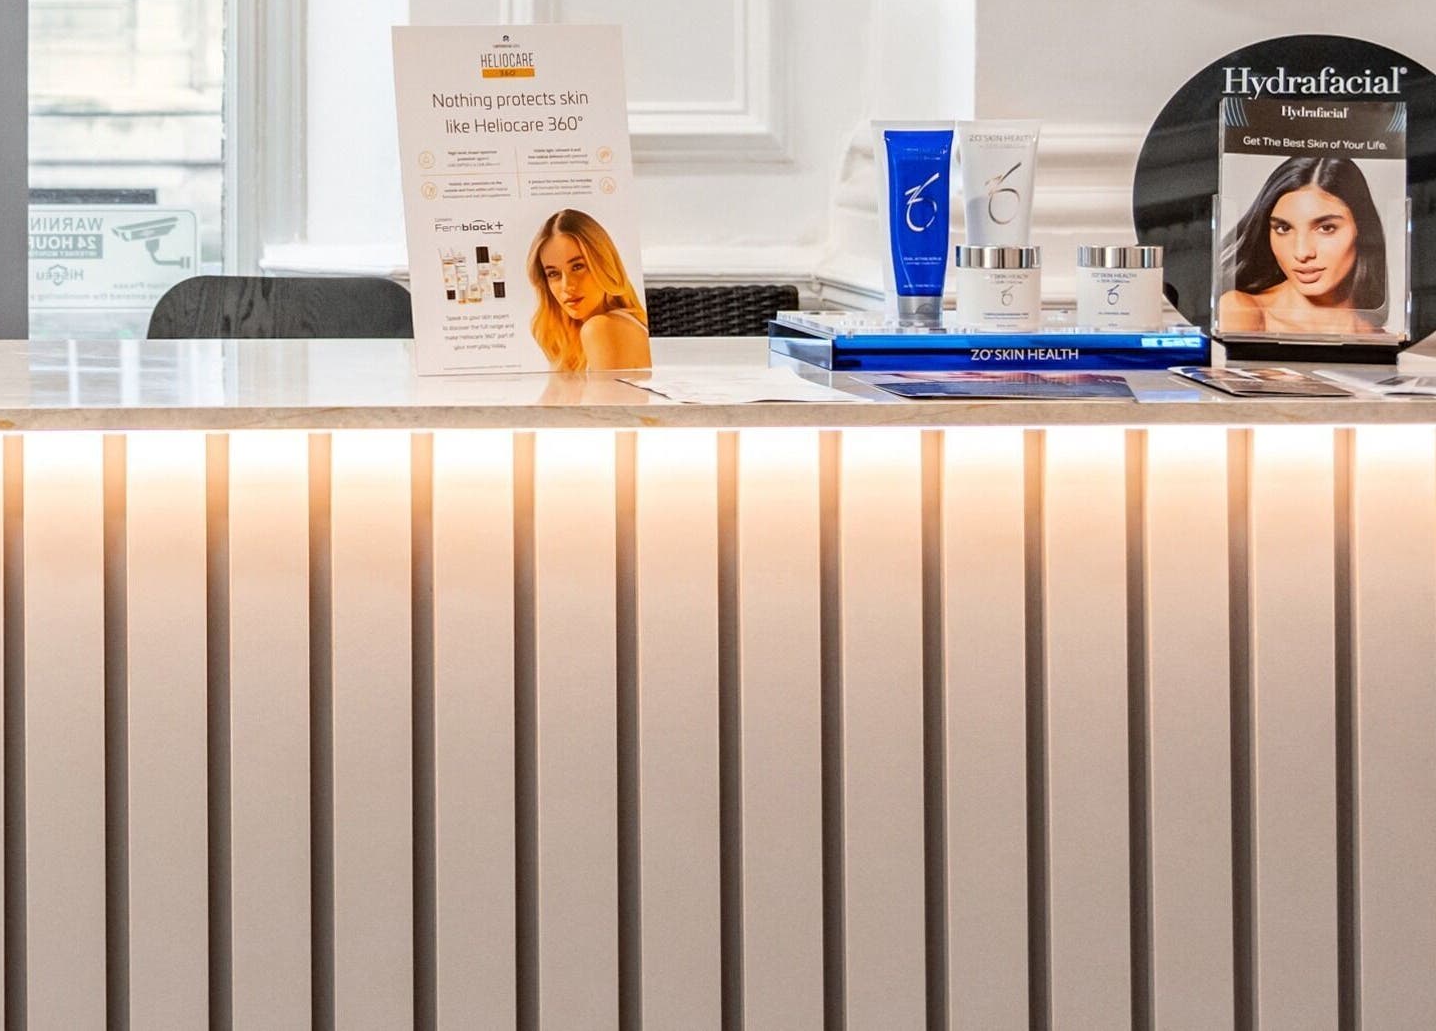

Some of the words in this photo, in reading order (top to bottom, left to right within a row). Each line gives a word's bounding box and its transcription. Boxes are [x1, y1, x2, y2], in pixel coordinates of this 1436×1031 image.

[480, 52, 535, 68] HELIOCARE
[432, 93, 493, 110] Nothing
[496, 92, 556, 109] protects
[560, 90, 589, 106] skin
[445, 119, 470, 134] like
[475, 119, 544, 133] Heliocare
[547, 116, 584, 131] 360°
[1243, 136, 1260, 146] Get
[1263, 137, 1281, 147] The
[1283, 137, 1305, 148] Best
[1307, 139, 1328, 149] Skin
[1330, 140, 1341, 149] of
[1342, 140, 1365, 150] Your
[1367, 140, 1387, 151] Life.
[994, 349, 1025, 361] SKIN
[1027, 348, 1079, 360] HEALTH
